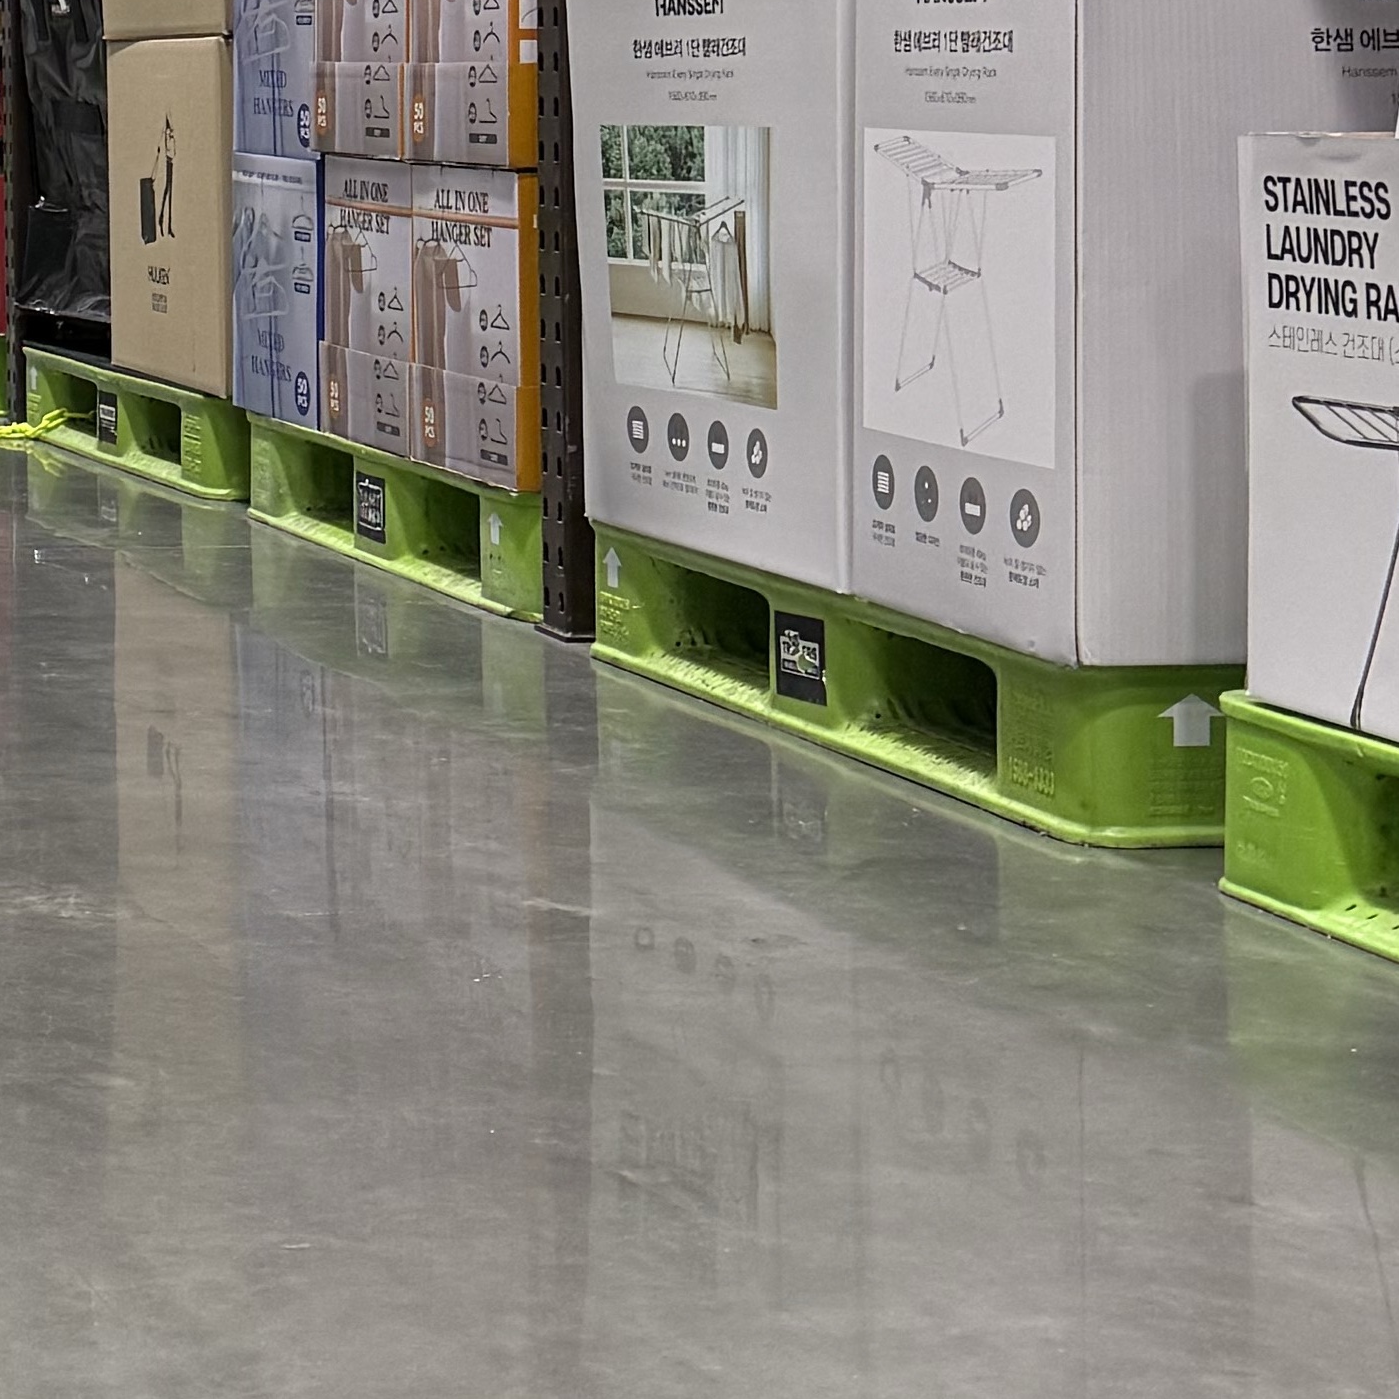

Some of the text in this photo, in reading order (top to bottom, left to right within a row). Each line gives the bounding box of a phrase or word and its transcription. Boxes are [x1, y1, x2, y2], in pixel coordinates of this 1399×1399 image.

[1311, 27, 1354, 53] 한샘
[1342, 65, 1397, 78] Hanssem
[343, 179, 358, 201] ALL
[370, 182, 389, 203] ONE
[434, 188, 489, 214] ALL IN ONE
[1263, 175, 1391, 221] STAINLESS
[374, 213, 390, 235] SET
[431, 221, 492, 248] HANGER SET
[1266, 223, 1379, 270] LAUNDRY
[1268, 272, 1358, 319] DRYING
[1268, 324, 1385, 362] 스테인레스 건조대
